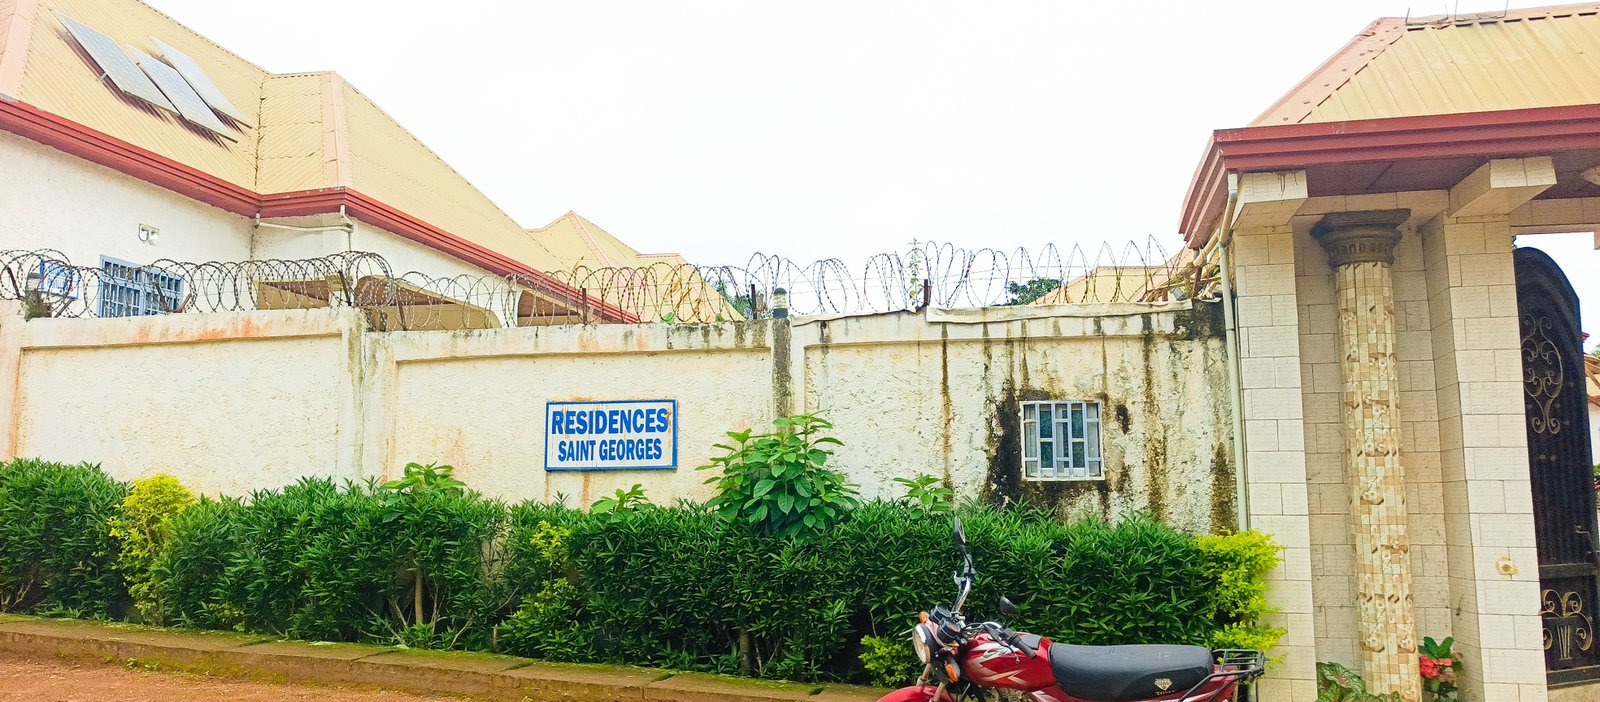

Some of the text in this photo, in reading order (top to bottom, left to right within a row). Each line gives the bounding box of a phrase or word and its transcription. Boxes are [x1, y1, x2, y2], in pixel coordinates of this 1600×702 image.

[551, 408, 669, 434] RESIDENCES
[558, 438, 662, 462] SAINT GEORGES
